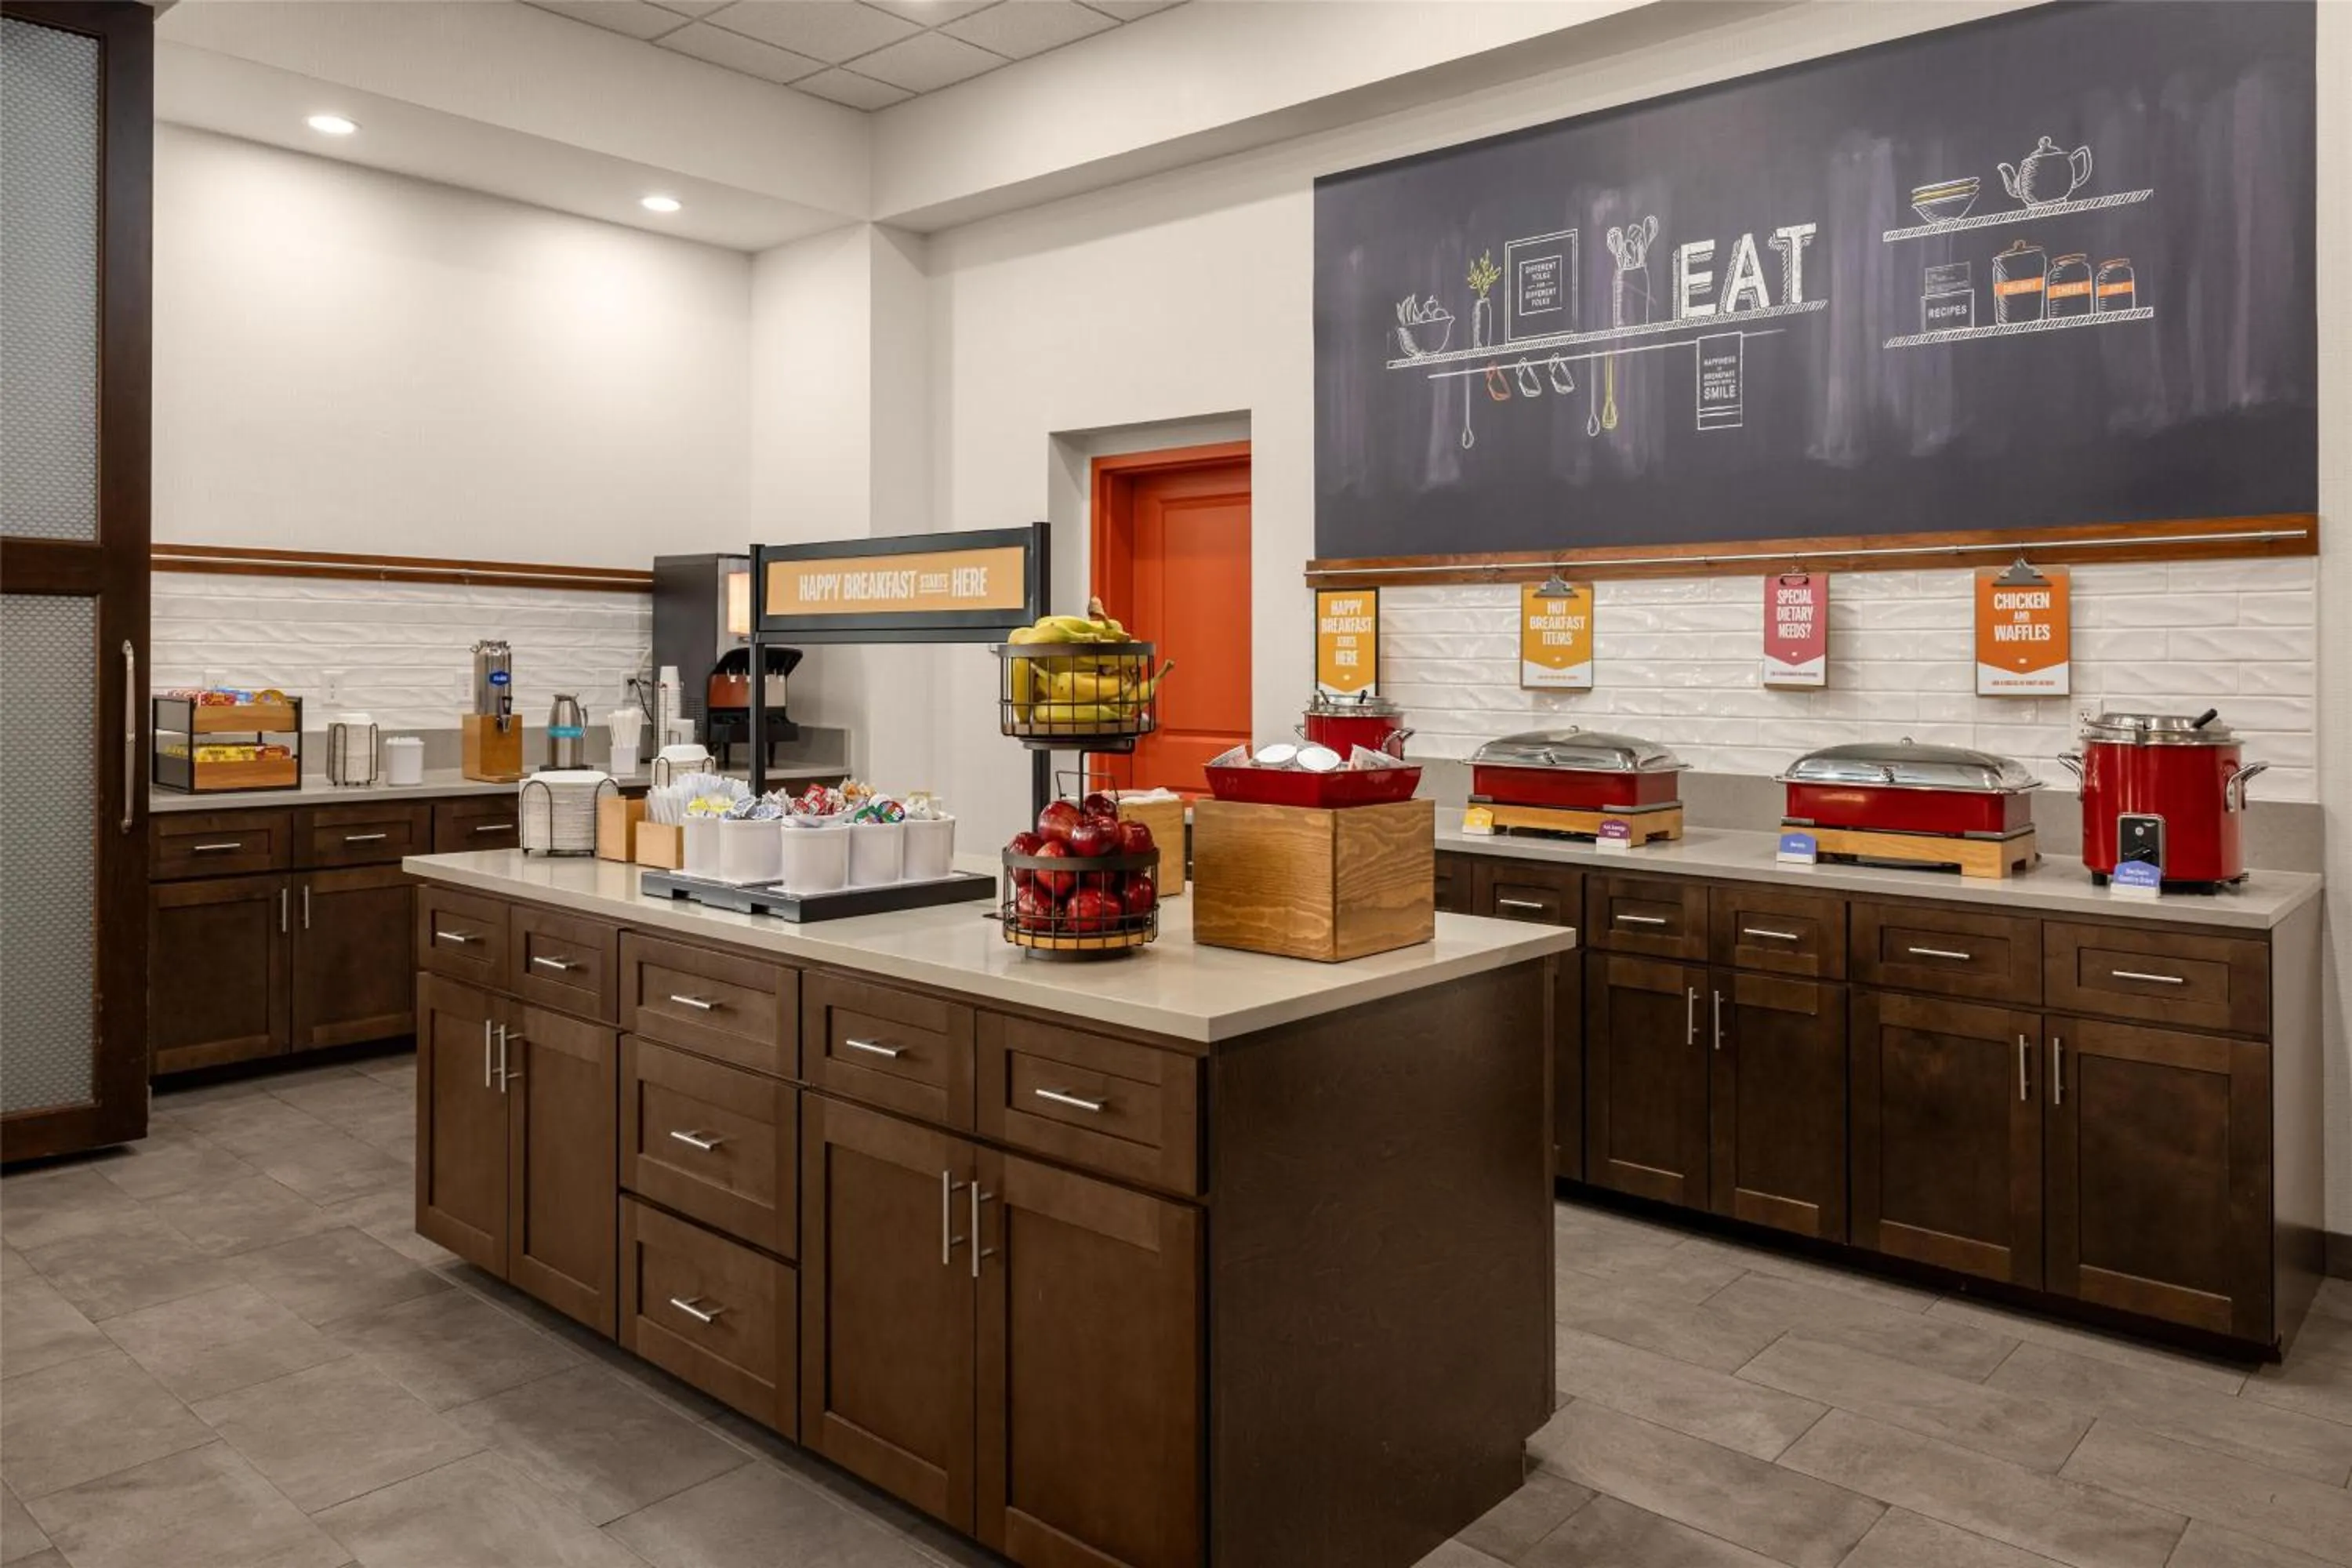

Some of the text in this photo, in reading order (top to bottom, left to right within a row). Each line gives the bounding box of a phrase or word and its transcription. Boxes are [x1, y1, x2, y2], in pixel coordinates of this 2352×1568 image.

[1525, 261, 1556, 274] DIFFERENT
[1675, 223, 1817, 319] EAT
[1525, 287, 1556, 299] DIFFERENT
[1928, 304, 1967, 318] RECIPES
[1704, 385, 1737, 400] SMILE
[799, 573, 841, 601] HAPPY
[844, 570, 916, 600] BREAKFAST
[952, 567, 988, 597] HERE
[1777, 589, 1813, 604] SPECIAL
[1994, 592, 2050, 610] CHICKEN
[1330, 599, 1363, 615] HAPPY
[1547, 601, 1566, 615] HOT
[1777, 605, 1813, 622] DIETARY
[1530, 615, 1585, 630] BREAKFAST
[2014, 611, 2031, 620] AND
[1321, 616, 1372, 633] BREAKFAST
[1778, 622, 1812, 639] NEEDS?
[1542, 631, 1573, 645] ITEMS
[1994, 624, 2051, 642] WAFFLES
[1335, 650, 1358, 666] HERE
